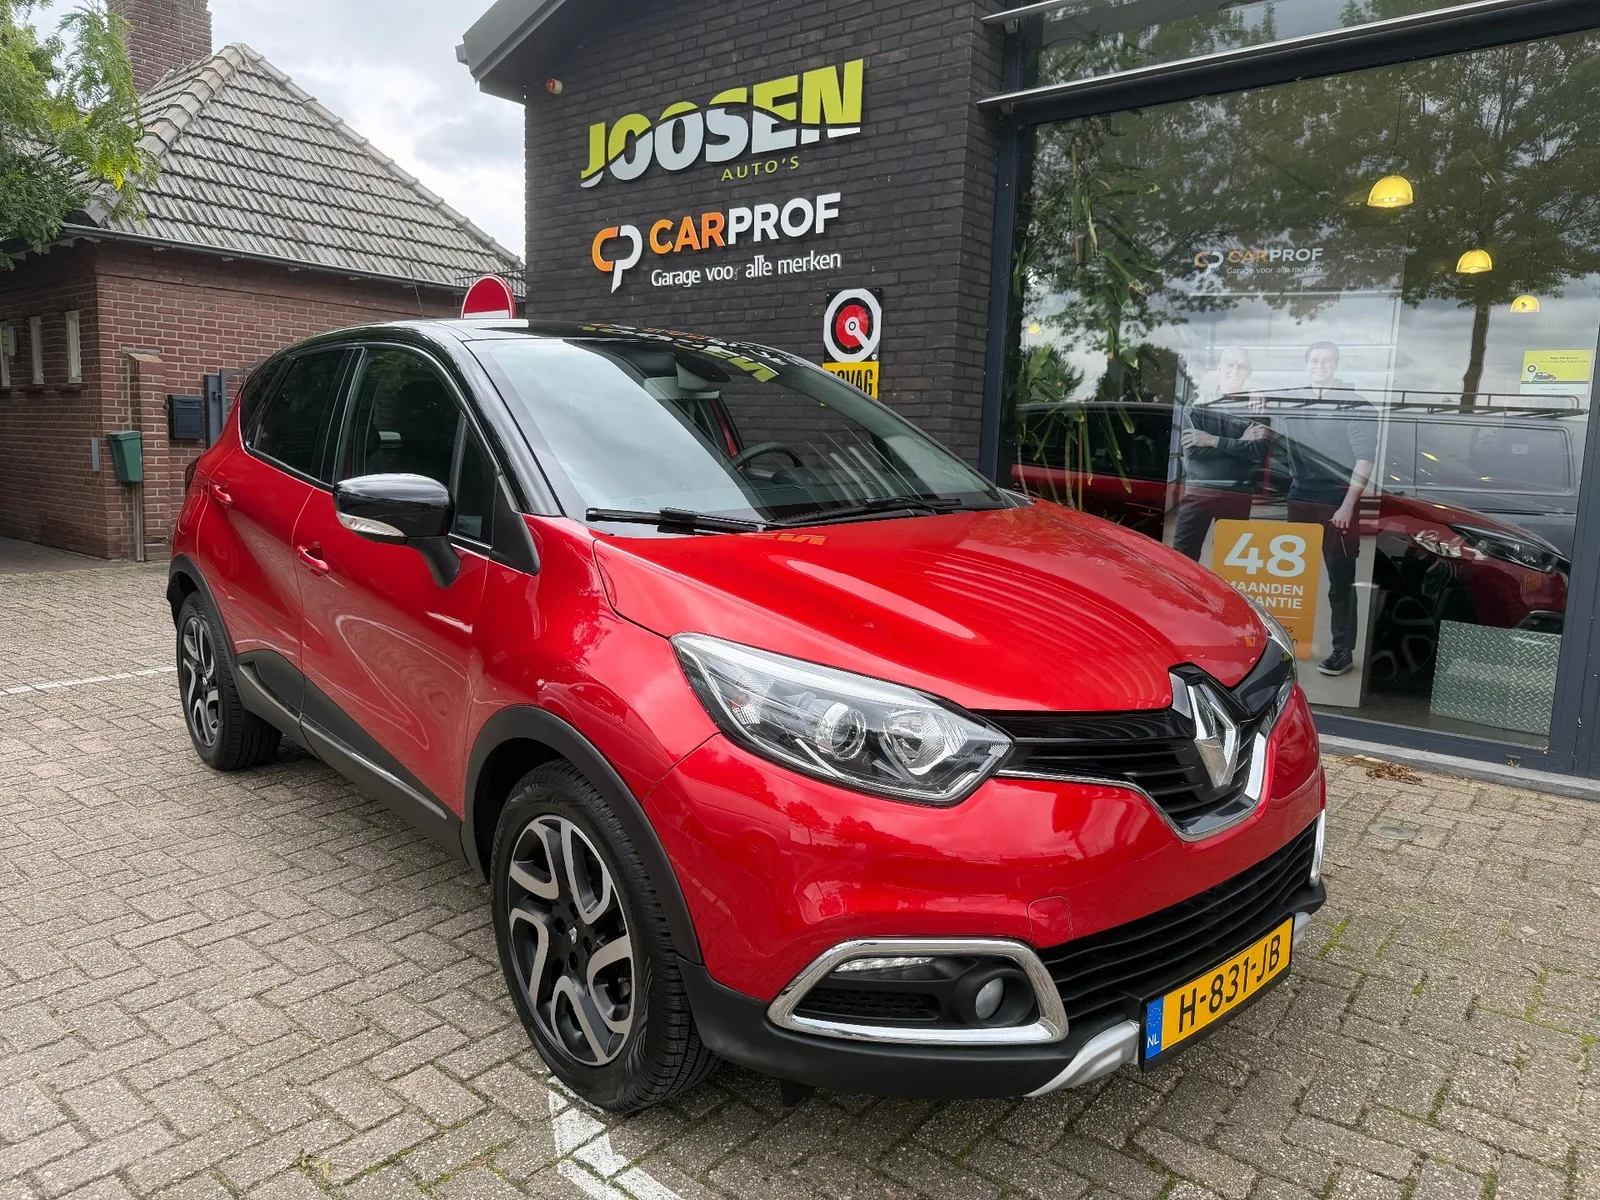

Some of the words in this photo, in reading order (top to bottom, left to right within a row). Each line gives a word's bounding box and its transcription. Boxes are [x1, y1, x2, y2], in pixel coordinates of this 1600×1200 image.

[580, 58, 864, 189] JOOSEN
[720, 156, 800, 182] AUTO'S
[649, 192, 842, 255] CARPROF
[651, 269, 701, 288] Garage
[777, 250, 842, 275] merken
[1226, 266, 1254, 276] Garage
[1256, 266, 1274, 274] voor
[1291, 265, 1323, 274] merken
[1227, 247, 1324, 264] CARPROF
[829, 369, 874, 396] VAG
[1224, 532, 1306, 578] 48
[1178, 933, 1281, 1034] H-831-JB
[1146, 1033, 1160, 1049] NL
